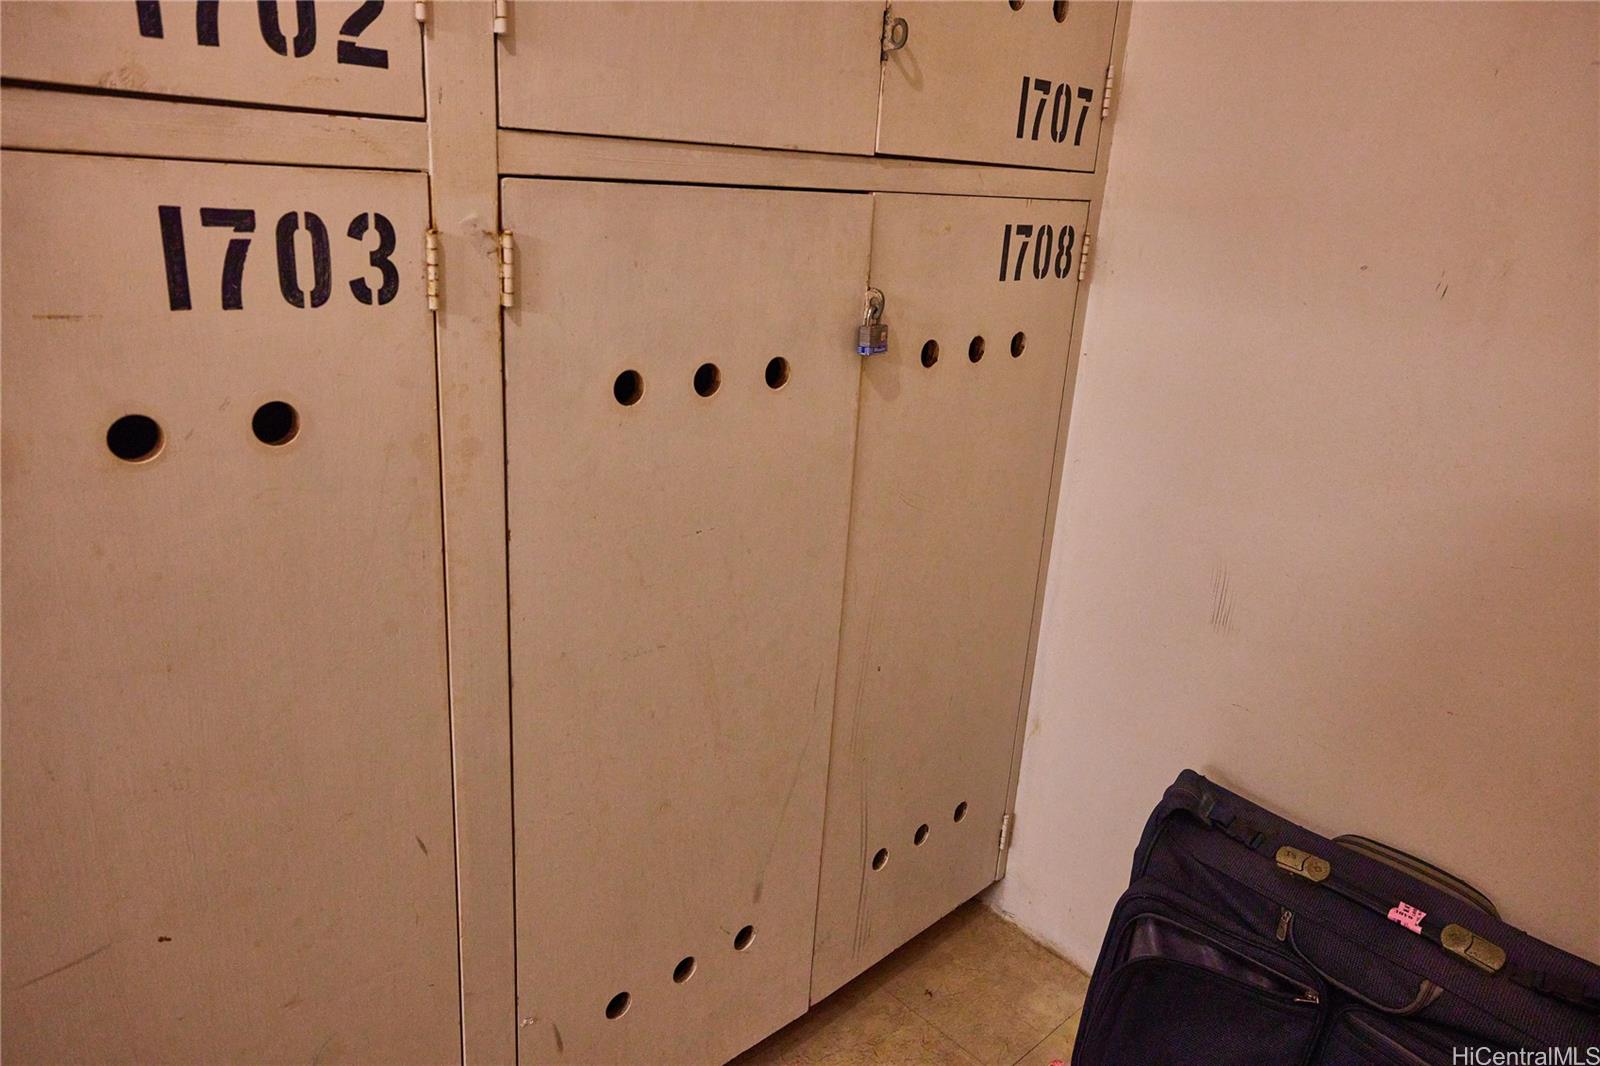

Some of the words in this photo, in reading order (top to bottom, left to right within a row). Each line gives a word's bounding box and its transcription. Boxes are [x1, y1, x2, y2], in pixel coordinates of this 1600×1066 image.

[1016, 75, 1094, 147] 1707
[158, 205, 400, 312] 1703
[999, 224, 1075, 282] 1708
